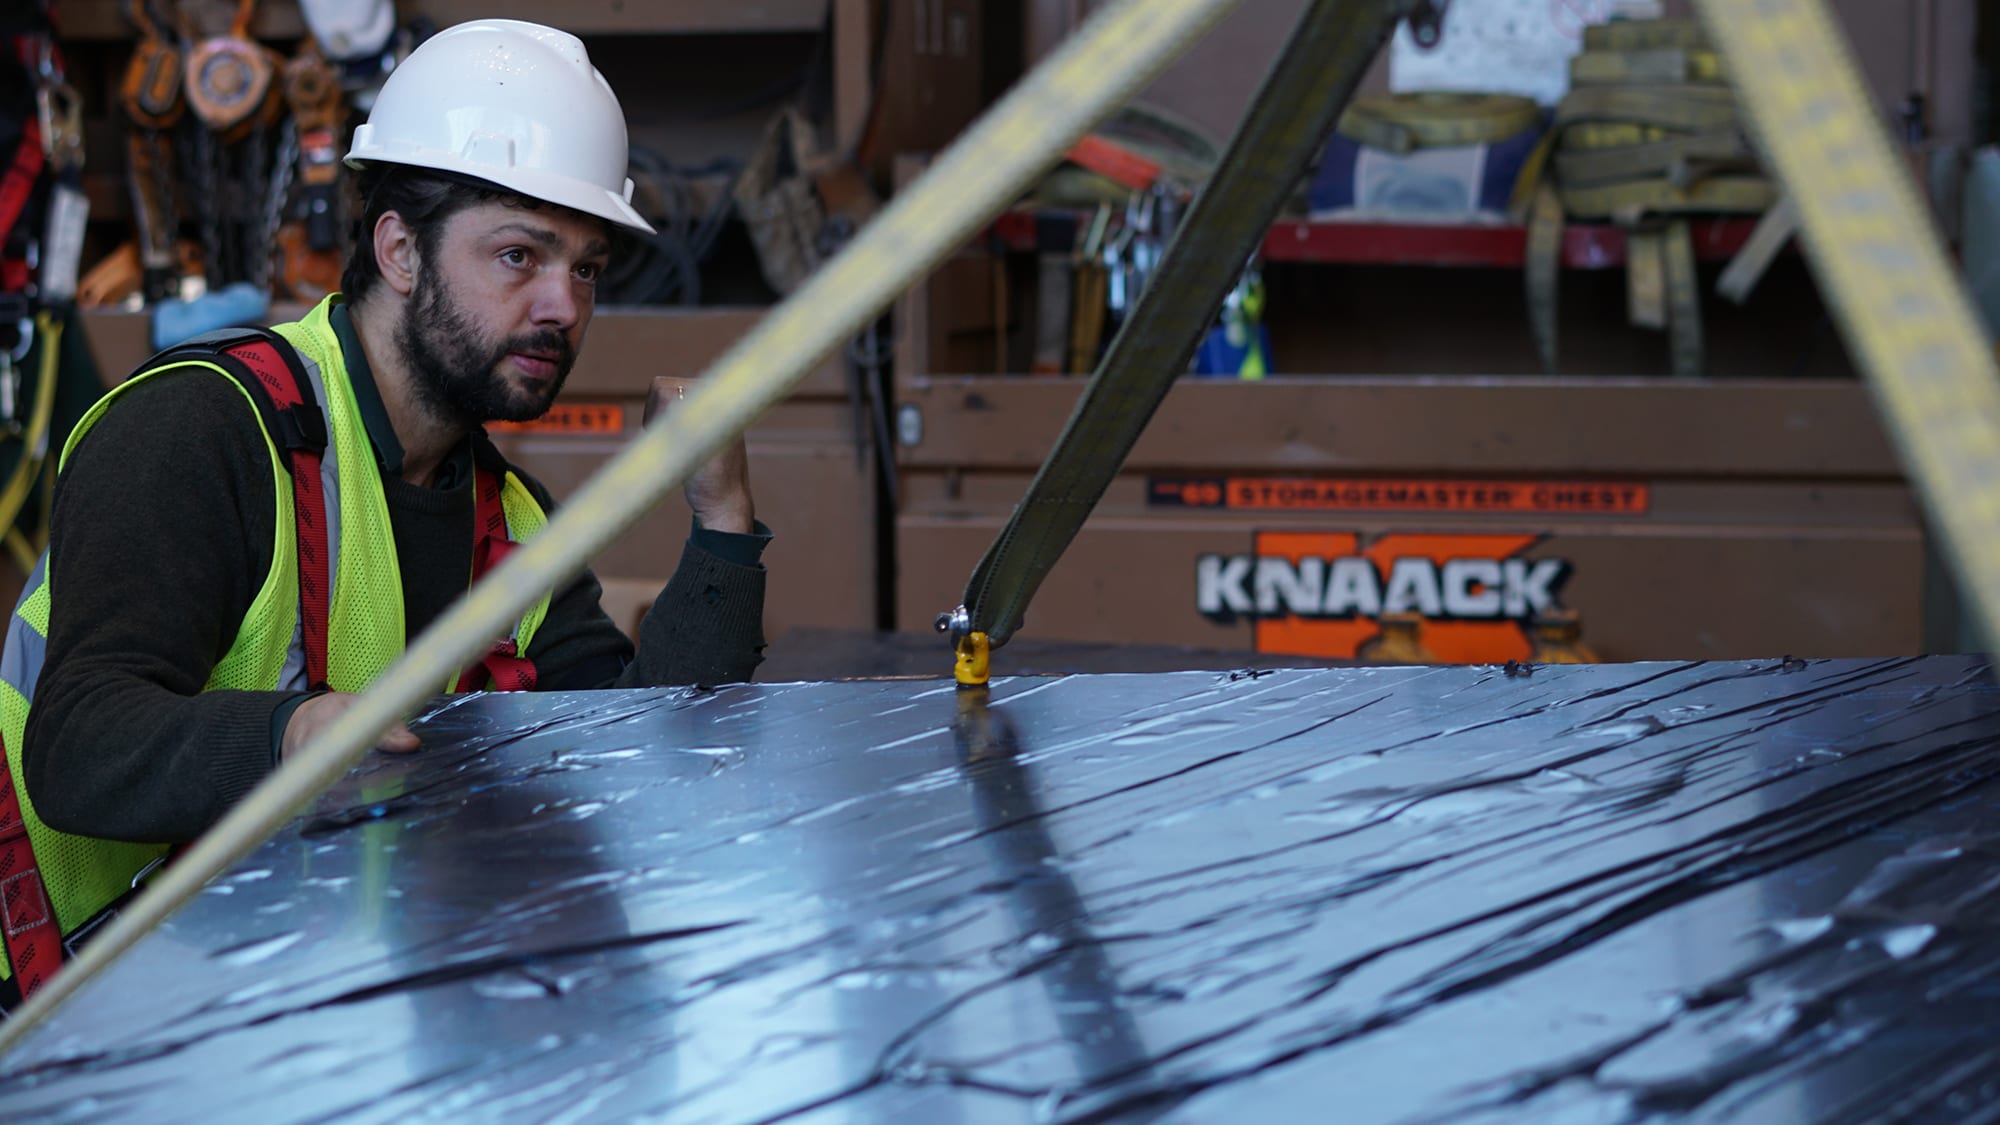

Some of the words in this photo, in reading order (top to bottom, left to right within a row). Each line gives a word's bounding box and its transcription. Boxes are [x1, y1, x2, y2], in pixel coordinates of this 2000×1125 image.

[1239, 483, 1512, 505] STORAGEMASTER
[1531, 486, 1635, 507] CHEST
[1198, 554, 1567, 618] KNAACK
